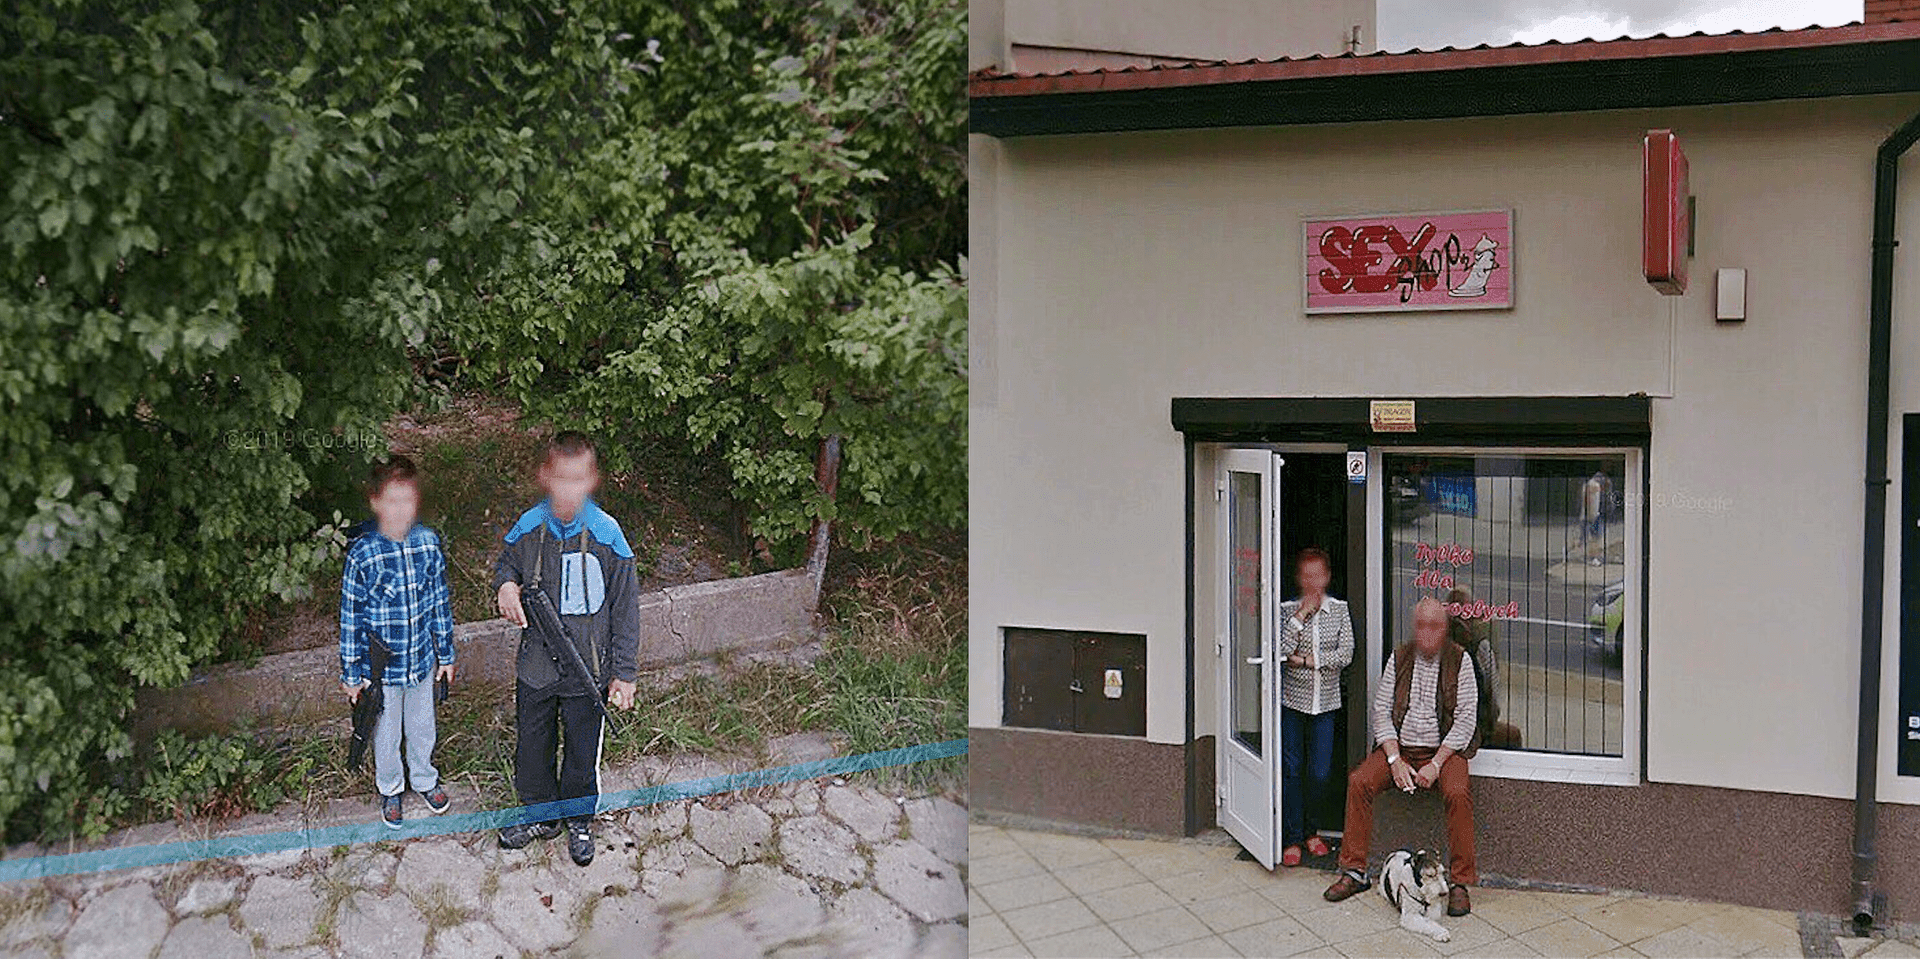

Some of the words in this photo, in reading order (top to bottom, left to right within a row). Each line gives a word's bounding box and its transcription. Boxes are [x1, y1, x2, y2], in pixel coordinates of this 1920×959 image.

[1319, 221, 1438, 295] SEX
[1415, 542, 1474, 568] Tylko
[1414, 568, 1454, 591] dla
